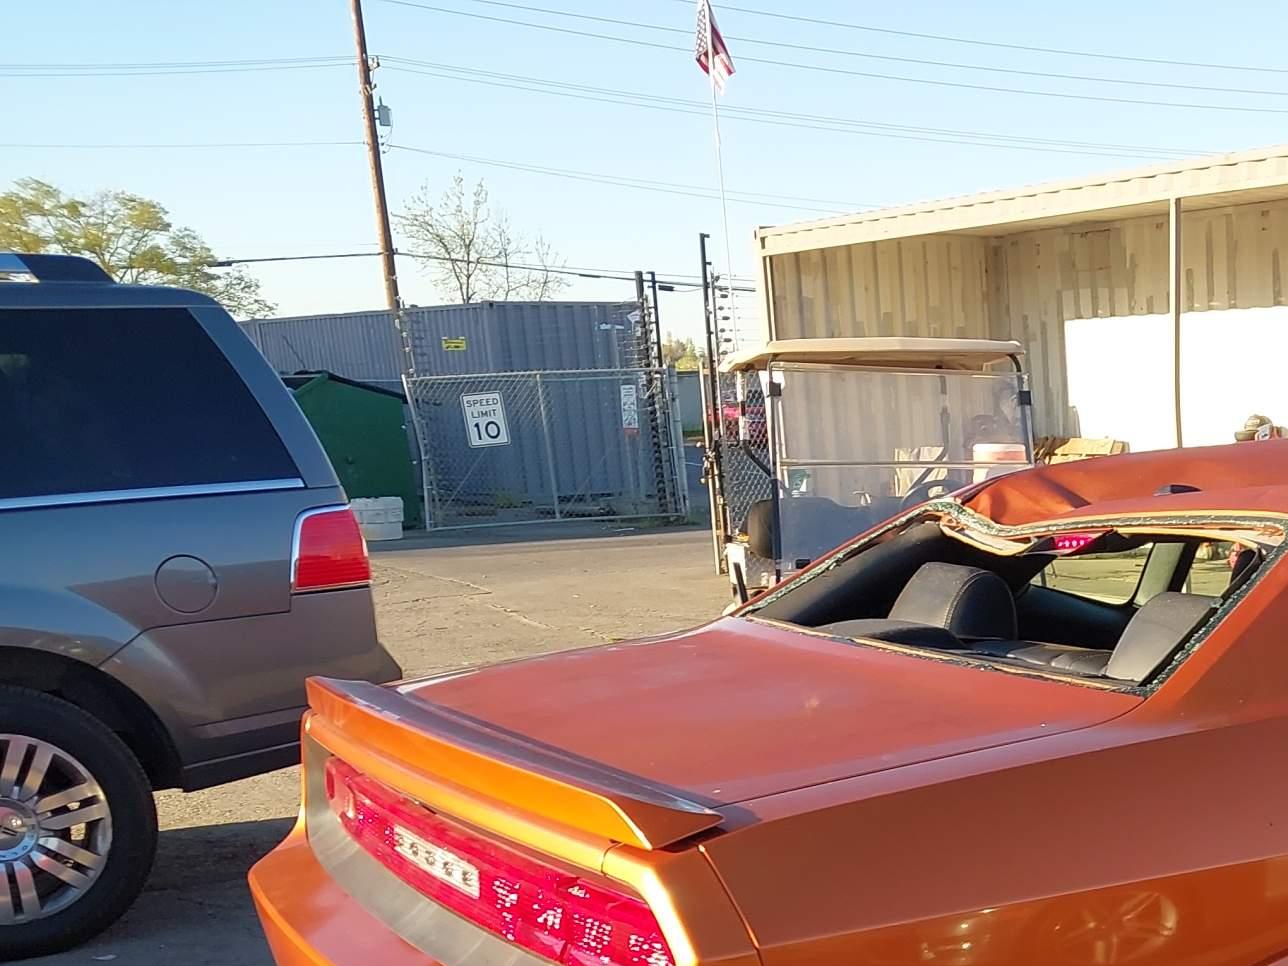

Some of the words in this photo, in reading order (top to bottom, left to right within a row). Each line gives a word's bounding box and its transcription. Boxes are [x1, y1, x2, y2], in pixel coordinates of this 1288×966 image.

[466, 397, 499, 408] SPEED
[471, 408, 497, 419] LIMIT
[474, 420, 501, 441] 10
